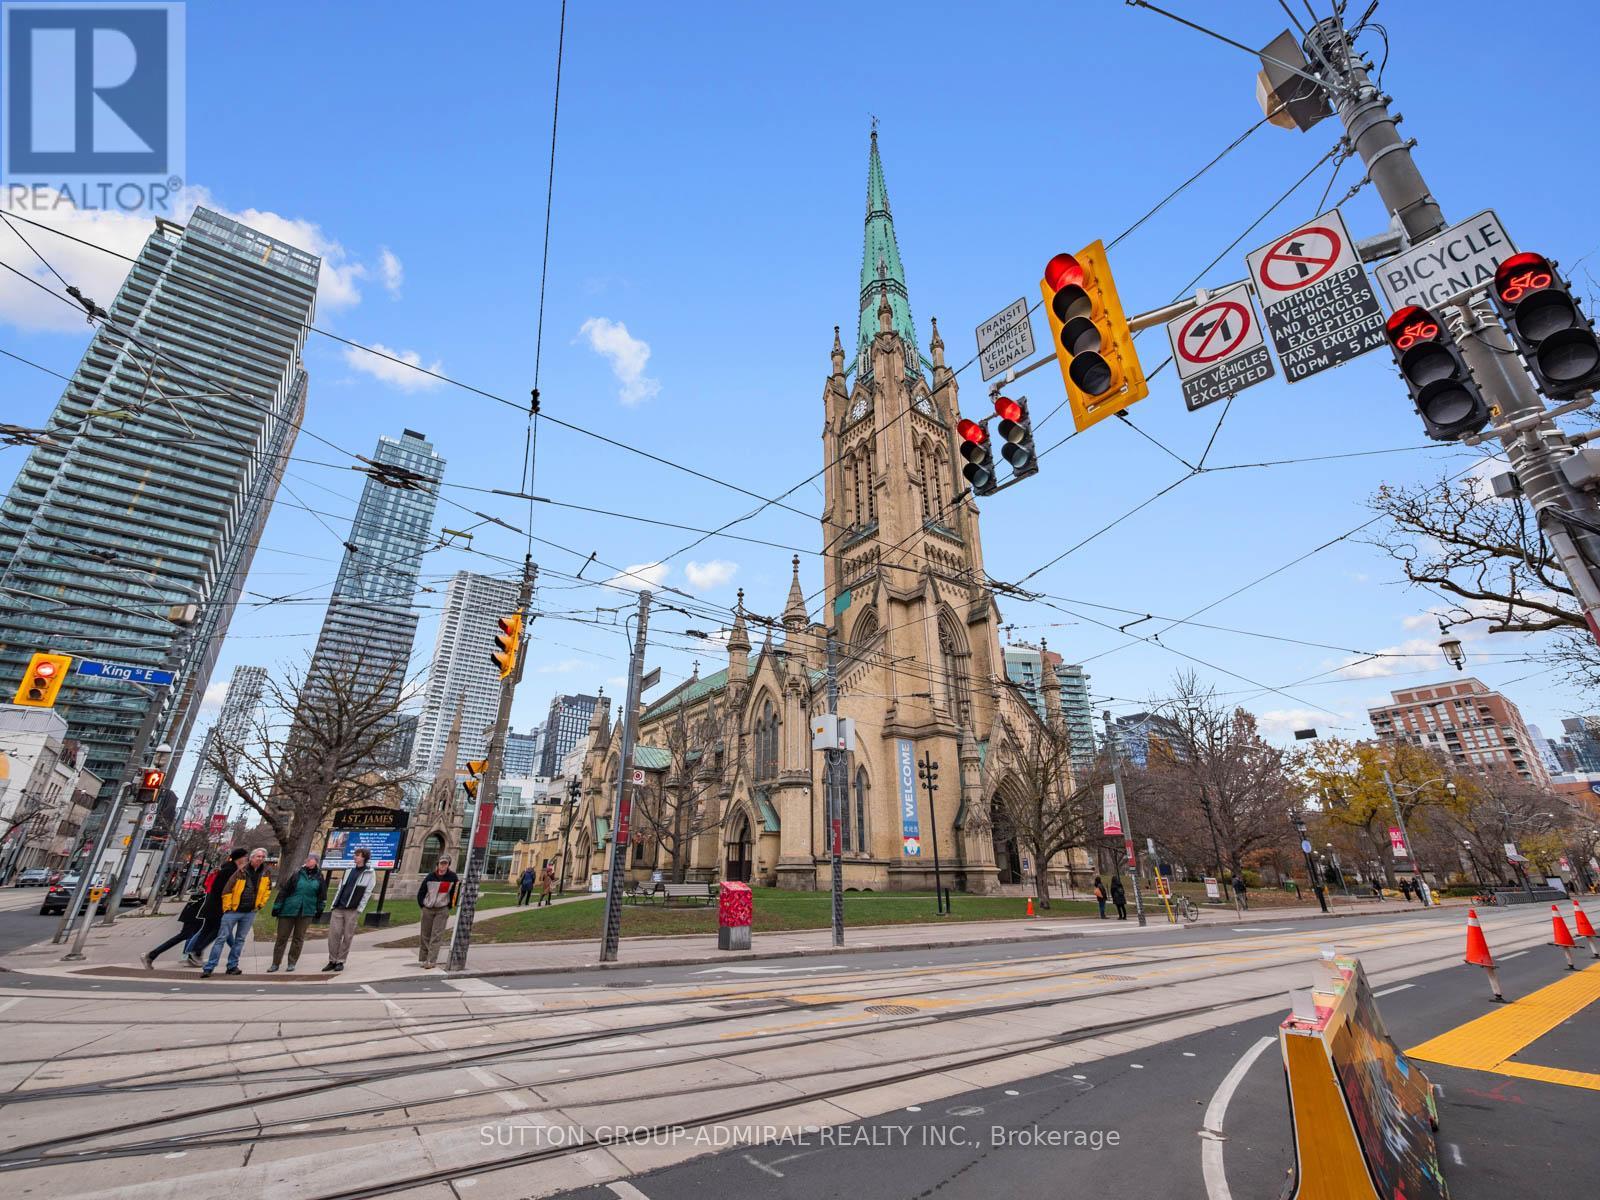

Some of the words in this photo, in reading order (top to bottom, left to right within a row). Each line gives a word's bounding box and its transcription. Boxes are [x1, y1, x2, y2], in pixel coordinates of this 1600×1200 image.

[1386, 223, 1502, 294] BICYCLE
[1268, 266, 1359, 317] AUTHORIZED
[1281, 283, 1353, 323] VEHICLES
[981, 304, 1022, 337] TRANSIT
[993, 322, 1012, 338] AND
[1274, 322, 1301, 341] AND
[1306, 288, 1371, 324] BICYCLES
[1287, 306, 1365, 349] EXCEPTED
[981, 321, 1028, 356] AUTHORIZED
[984, 332, 1027, 364] VEHICLE
[1281, 346, 1316, 367] TAXIS
[1322, 314, 1385, 350] EXCEPTED
[1350, 340, 1362, 354] 5
[1364, 331, 1386, 349] AM
[988, 345, 1027, 373] SIGNAL
[1184, 376, 1208, 395] TTC
[1210, 350, 1268, 384] VEHICLES
[1190, 365, 1268, 407] EXCEPTED
[101, 664, 132, 681] King
[135, 668, 143, 676] St
[144, 670, 155, 681] E
[901, 743, 915, 818] WELCOME
[348, 815, 361, 823] ST.
[363, 815, 394, 825] JAMES
